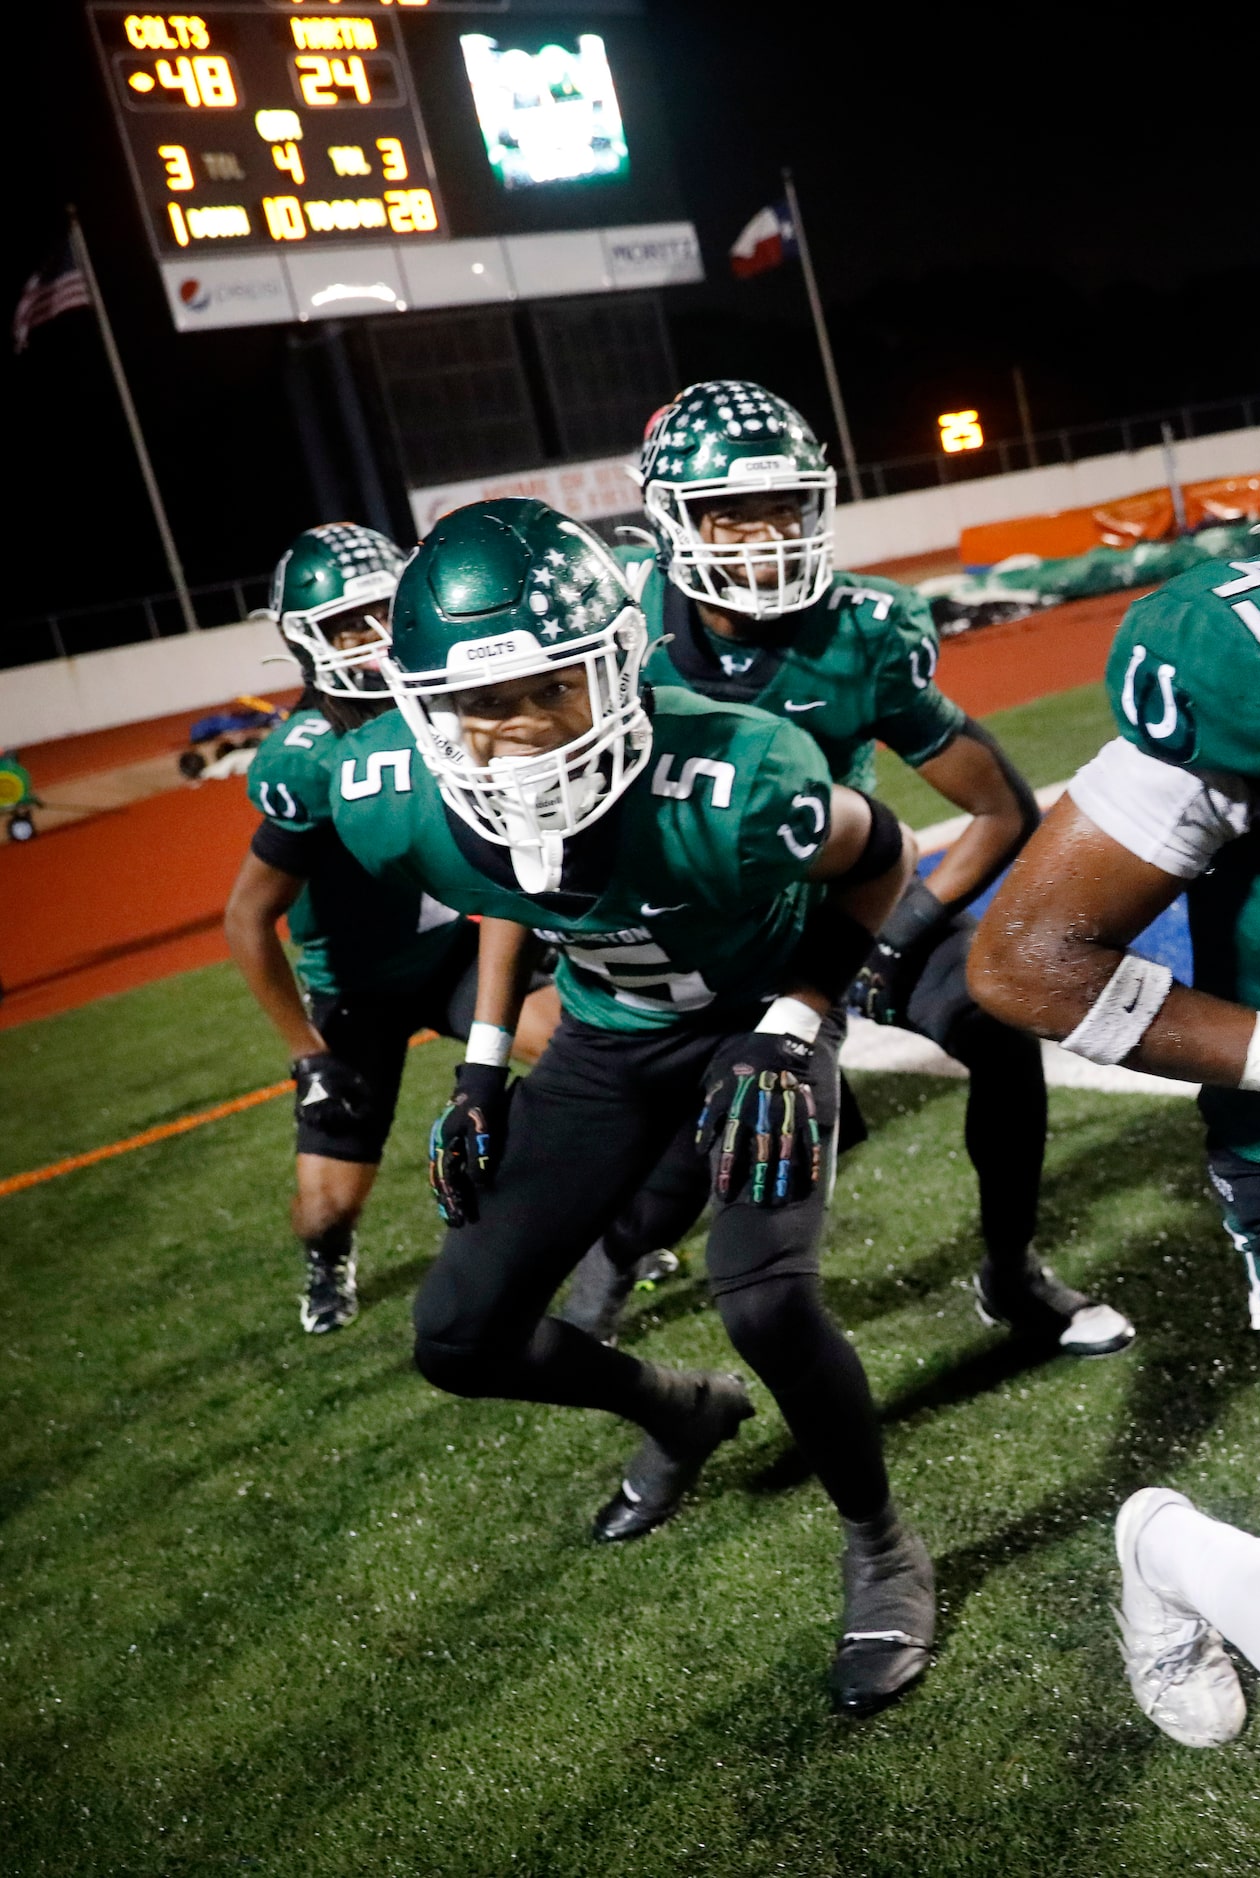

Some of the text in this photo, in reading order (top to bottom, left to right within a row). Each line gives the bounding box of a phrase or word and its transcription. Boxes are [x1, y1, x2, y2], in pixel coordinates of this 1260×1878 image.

[124, 15, 210, 49] COLTS
[155, 56, 371, 107] 48 24
[158, 145, 194, 190] 3
[271, 142, 305, 184] 4
[376, 138, 408, 180] 3
[167, 202, 189, 247] 1
[262, 195, 306, 240] 10
[384, 188, 438, 232] 28
[938, 411, 984, 452] 25
[745, 460, 781, 471] COLTS
[467, 641, 516, 660] COLTS
[284, 718, 332, 749] 2
[340, 748, 411, 802] 5
[652, 753, 735, 808] 5
